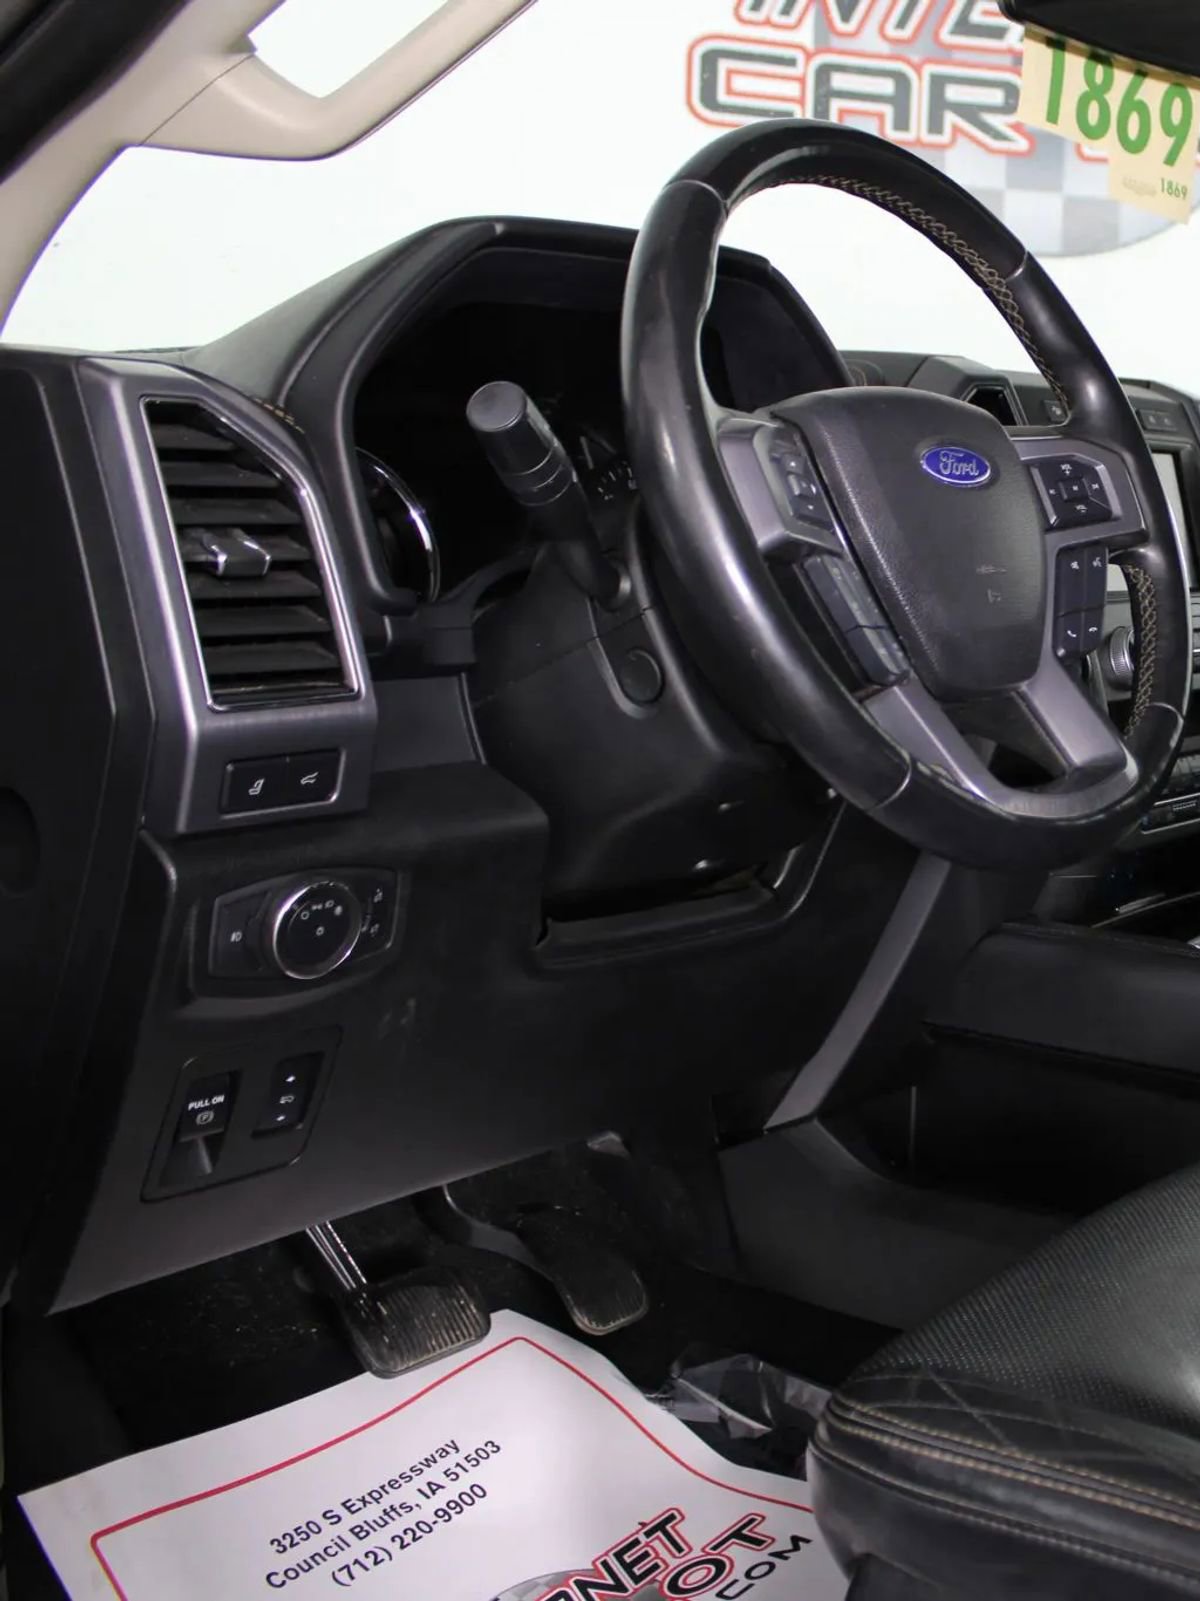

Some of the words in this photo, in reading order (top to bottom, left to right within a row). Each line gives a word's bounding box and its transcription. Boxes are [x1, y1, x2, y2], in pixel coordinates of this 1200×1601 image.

[690, 40, 1031, 151] CAR
[1044, 36, 1194, 168] 1869
[1160, 177, 1188, 200] 1869
[940, 450, 980, 476] Ford
[188, 1098, 211, 1111] PULL
[211, 1094, 225, 1105] ON
[265, 1535, 351, 1589] Council
[348, 1500, 422, 1541] Bluffs,
[416, 1480, 446, 1500] IA
[442, 1440, 502, 1482] 51503
[270, 1520, 323, 1554] 3250
[322, 1508, 343, 1526] S
[340, 1439, 460, 1515] Expressway
[331, 1546, 393, 1587] (712)
[390, 1483, 488, 1550] 220-9900
[663, 1514, 773, 1599] OT
